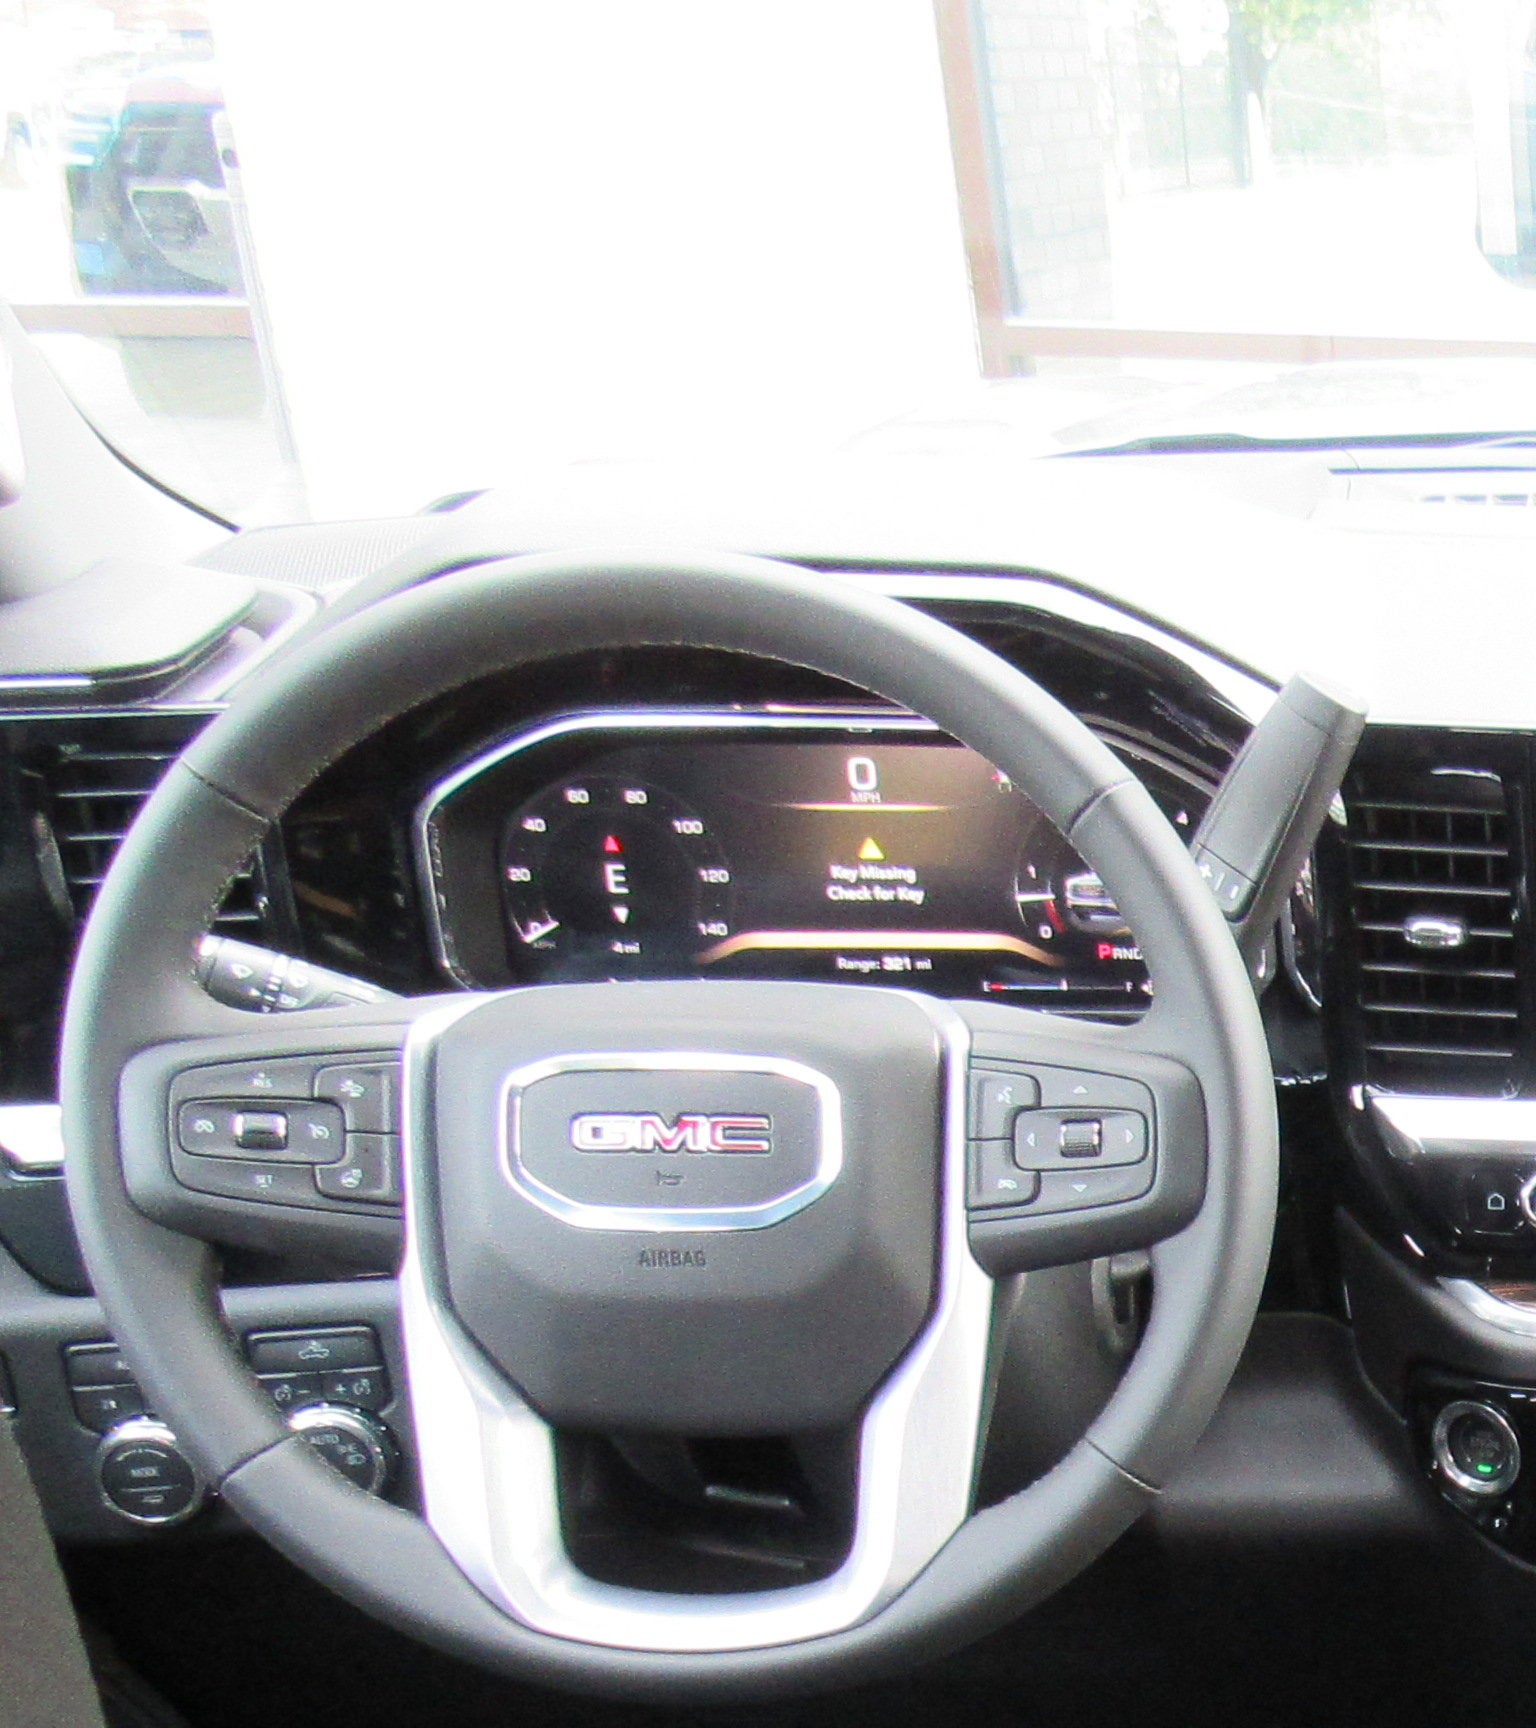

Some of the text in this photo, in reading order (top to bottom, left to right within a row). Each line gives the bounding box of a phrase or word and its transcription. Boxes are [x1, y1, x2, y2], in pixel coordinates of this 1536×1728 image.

[849, 757, 877, 791] 0
[564, 788, 590, 805] 60
[623, 788, 648, 805] 80
[851, 792, 881, 803] MPH
[521, 817, 547, 833] 40
[671, 819, 703, 835] 100
[505, 867, 531, 883] 20
[604, 863, 629, 894] E
[699, 867, 730, 884] 120
[829, 865, 917, 884] Key Missing
[826, 886, 925, 905] Check for Key
[698, 922, 729, 937] 140
[1038, 924, 1054, 940] 0
[836, 954, 932, 972] Range: 321 mi
[569, 1114, 771, 1152] GMC
[637, 1250, 707, 1267] AIRBAG
